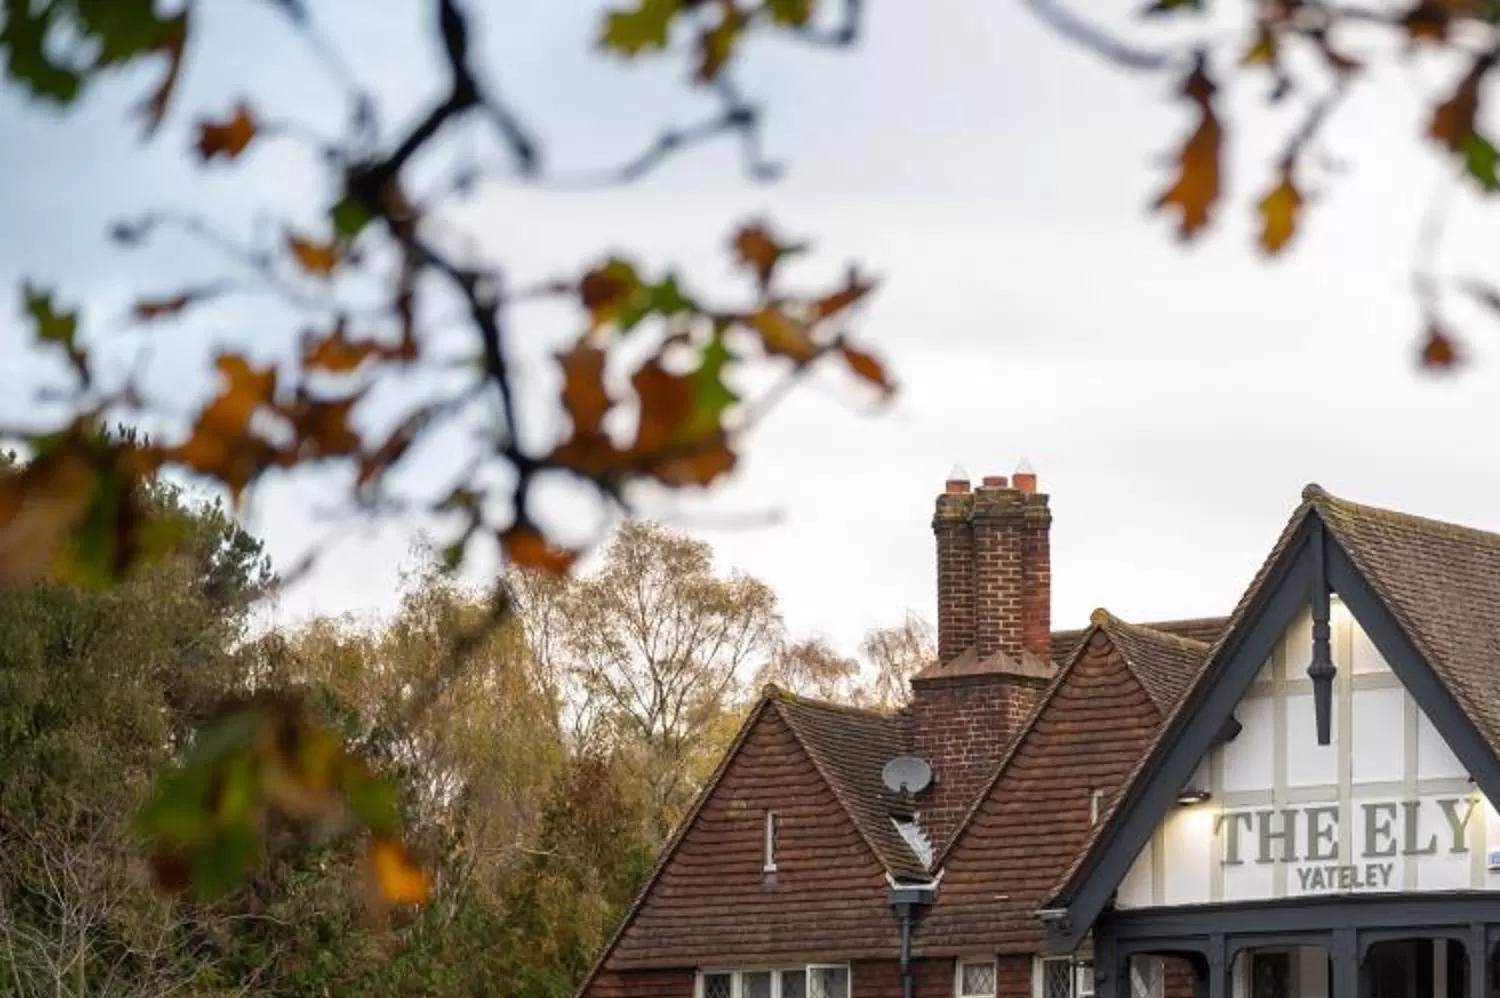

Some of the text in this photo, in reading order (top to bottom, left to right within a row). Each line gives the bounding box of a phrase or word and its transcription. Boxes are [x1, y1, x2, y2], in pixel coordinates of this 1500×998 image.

[1213, 798, 1480, 865] THE ELY
[1297, 863, 1393, 890] YATELEY
